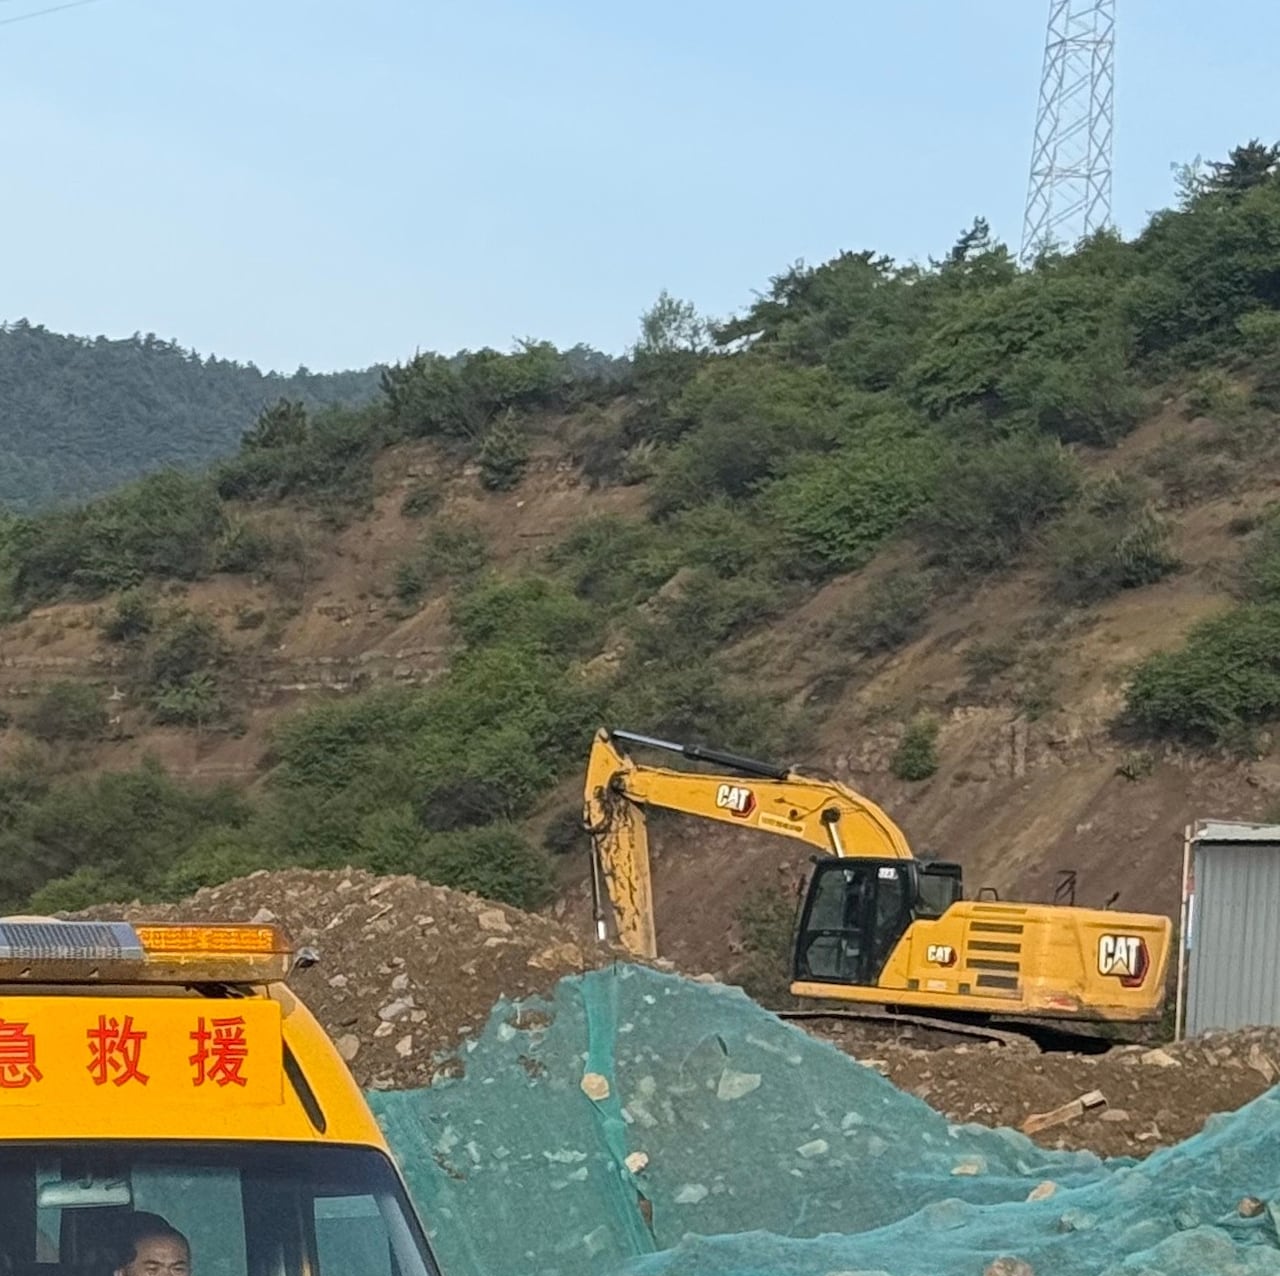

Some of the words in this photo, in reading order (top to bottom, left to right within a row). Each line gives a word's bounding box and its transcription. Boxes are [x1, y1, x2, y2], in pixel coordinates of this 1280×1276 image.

[716, 784, 750, 811] CAT
[927, 945, 952, 963] CAT
[1099, 935, 1140, 975] CAT
